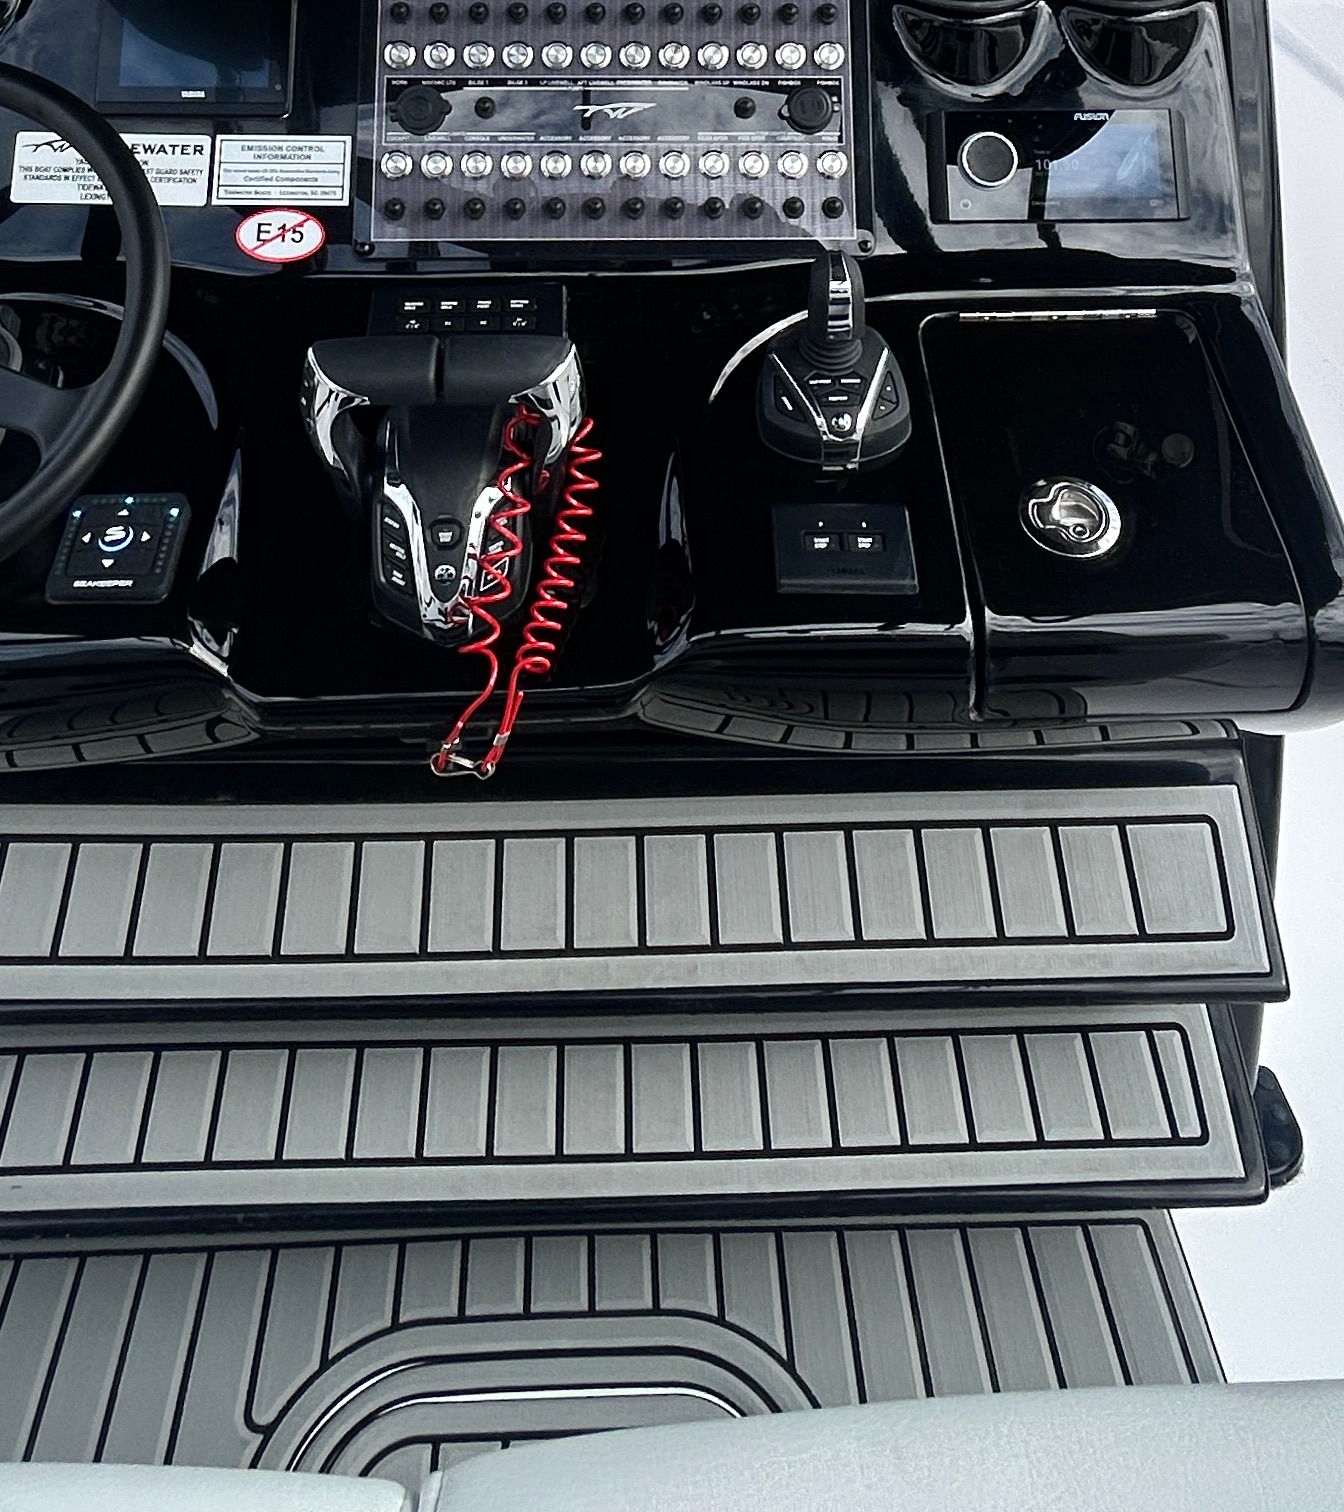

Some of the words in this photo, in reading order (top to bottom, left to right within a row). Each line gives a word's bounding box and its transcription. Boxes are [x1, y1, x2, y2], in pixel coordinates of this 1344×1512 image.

[131, 143, 204, 155] EWATER
[241, 144, 284, 152] EMISSION
[286, 145, 324, 153] CONTROL
[253, 153, 312, 161] INFORMATION
[256, 222, 304, 244] E15
